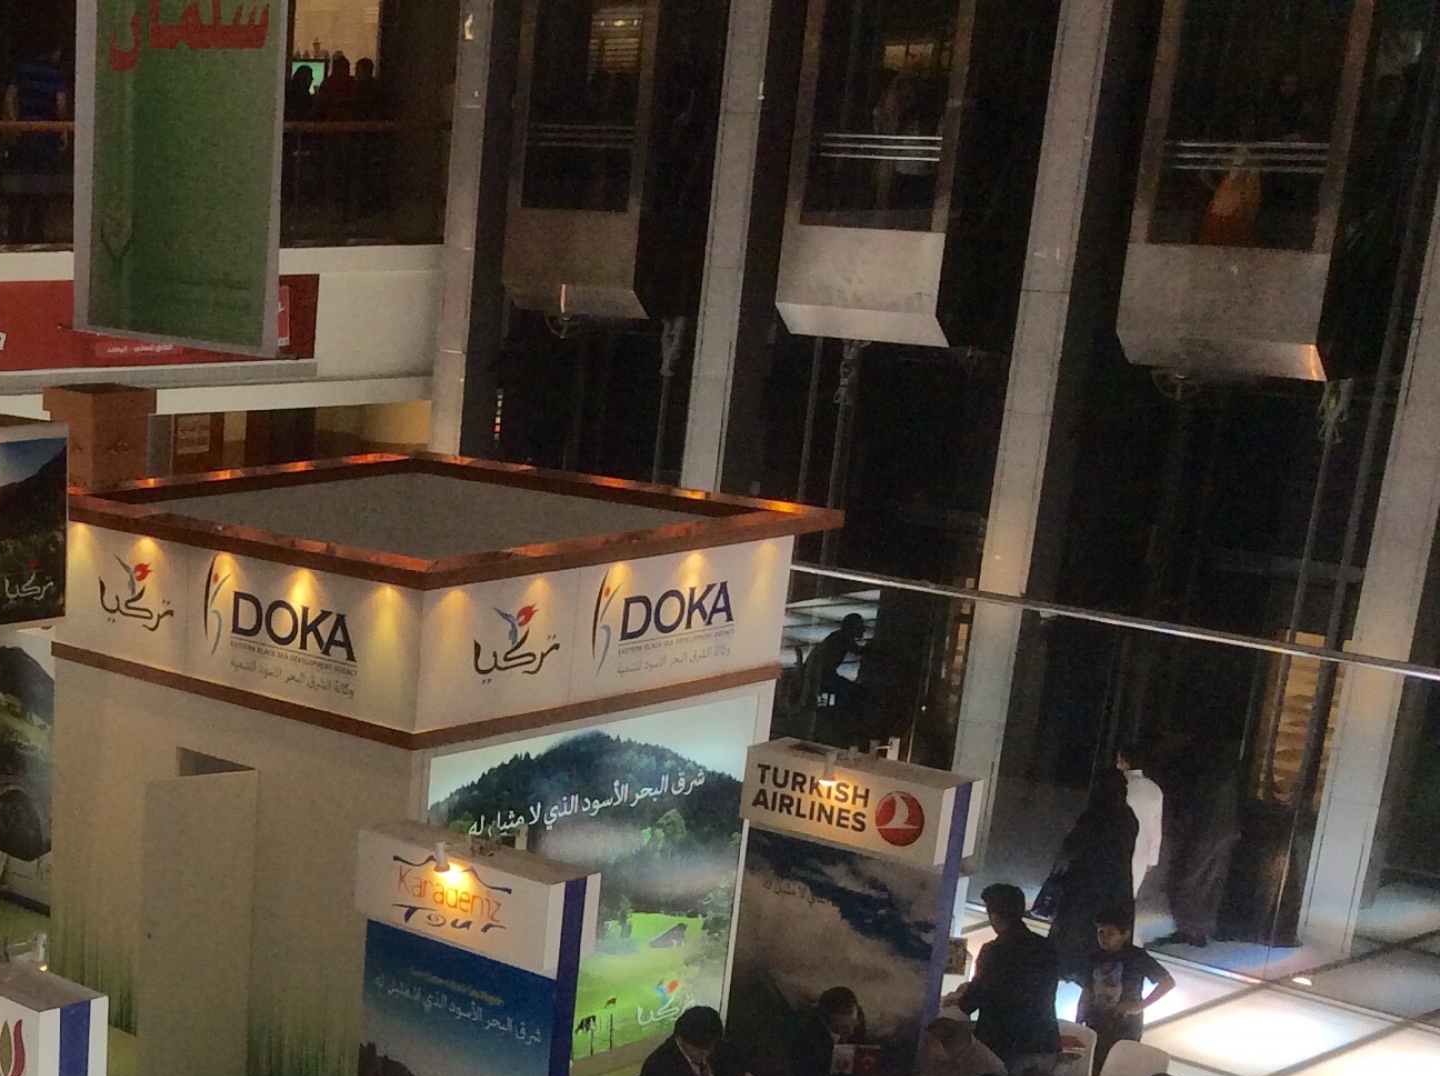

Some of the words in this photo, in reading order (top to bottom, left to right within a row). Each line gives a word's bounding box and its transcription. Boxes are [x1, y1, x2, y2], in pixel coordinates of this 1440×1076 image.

[99, 572, 174, 632] تركيا
[620, 581, 734, 641] DOKA
[230, 590, 357, 663] DOKA
[474, 626, 560, 684] تركيا
[582, 780, 629, 817] الأسود
[629, 774, 670, 808] البحر
[670, 767, 706, 796] شرق
[757, 763, 871, 808] TURKISH
[468, 815, 486, 836] له
[529, 802, 542, 825] لا
[544, 794, 579, 831] الذي
[751, 788, 867, 833] AIRLINES
[391, 903, 507, 933] Tour
